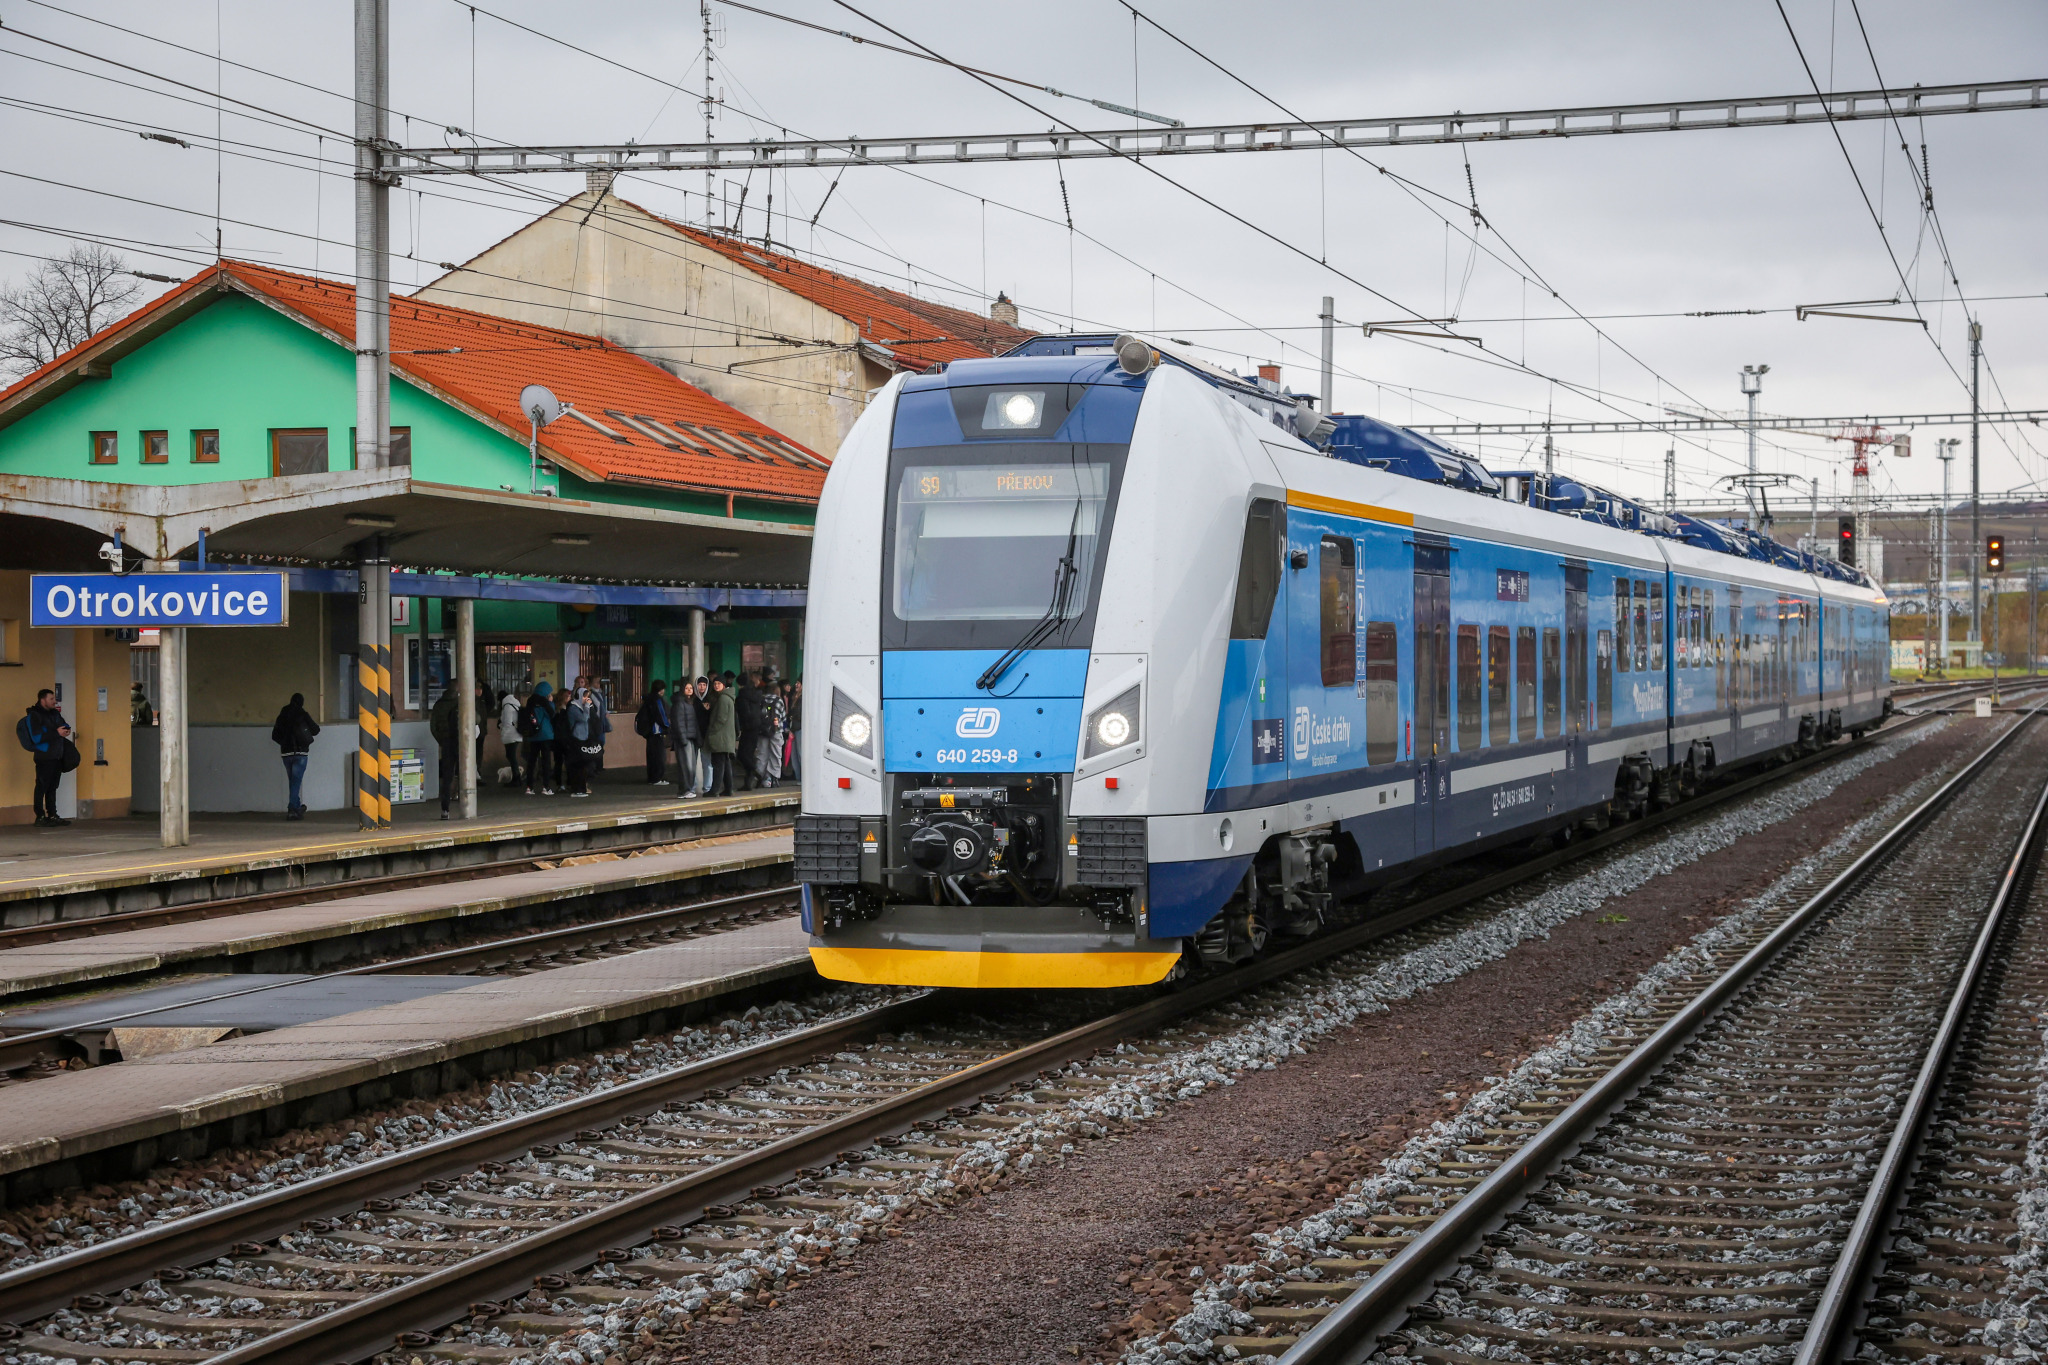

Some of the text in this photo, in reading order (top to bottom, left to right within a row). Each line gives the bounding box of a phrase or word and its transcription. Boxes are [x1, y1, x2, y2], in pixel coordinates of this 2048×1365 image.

[920, 472, 1053, 495] S9 PŘEROV
[47, 584, 269, 618] Otrokovice
[1311, 714, 1331, 745] České
[1332, 715, 1351, 748] dráhy
[936, 748, 1018, 764] 640 259-8
